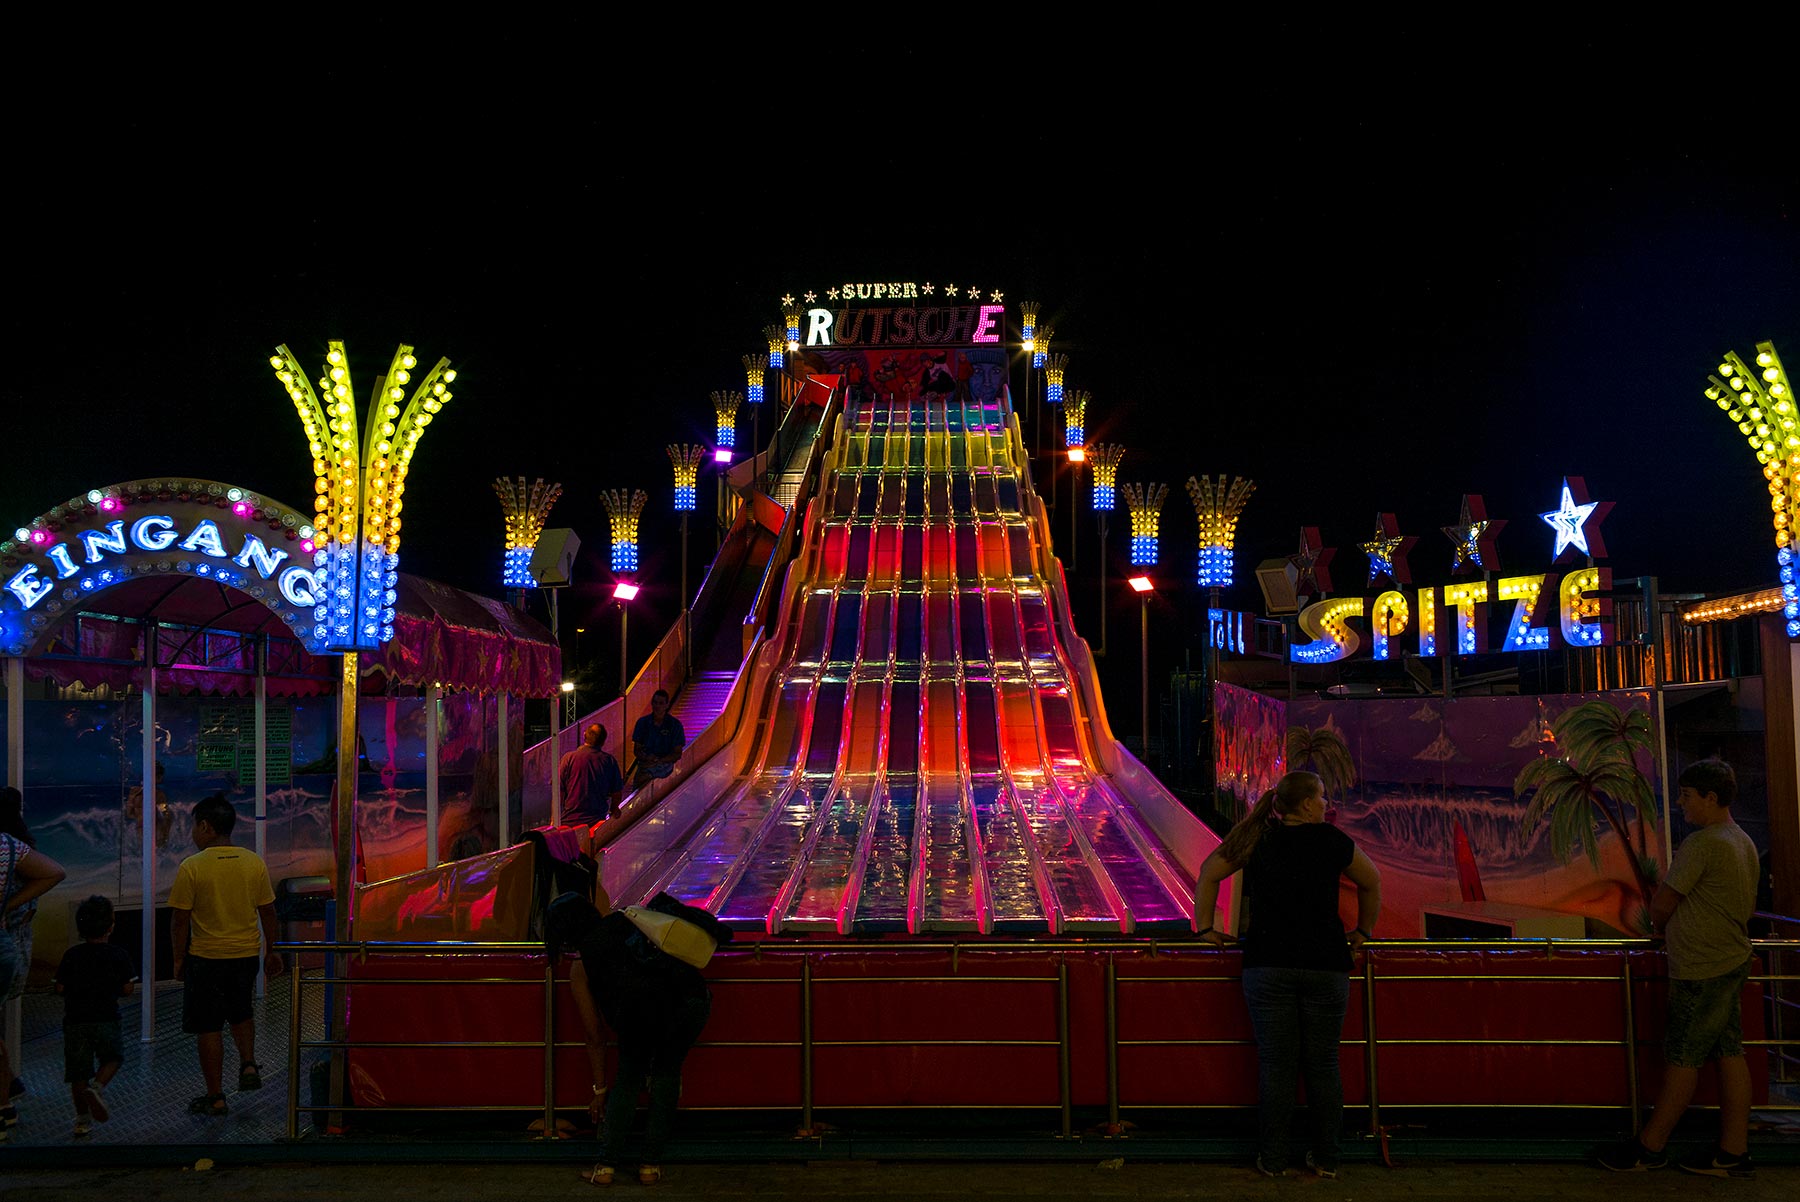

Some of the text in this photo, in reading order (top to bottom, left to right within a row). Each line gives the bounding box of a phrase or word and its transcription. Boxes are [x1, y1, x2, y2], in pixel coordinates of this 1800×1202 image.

[842, 282, 918, 299] SUPER
[806, 305, 1005, 346] RUTSCHE
[3, 514, 318, 610] EINGANG
[1291, 568, 1606, 663] SPITZE
